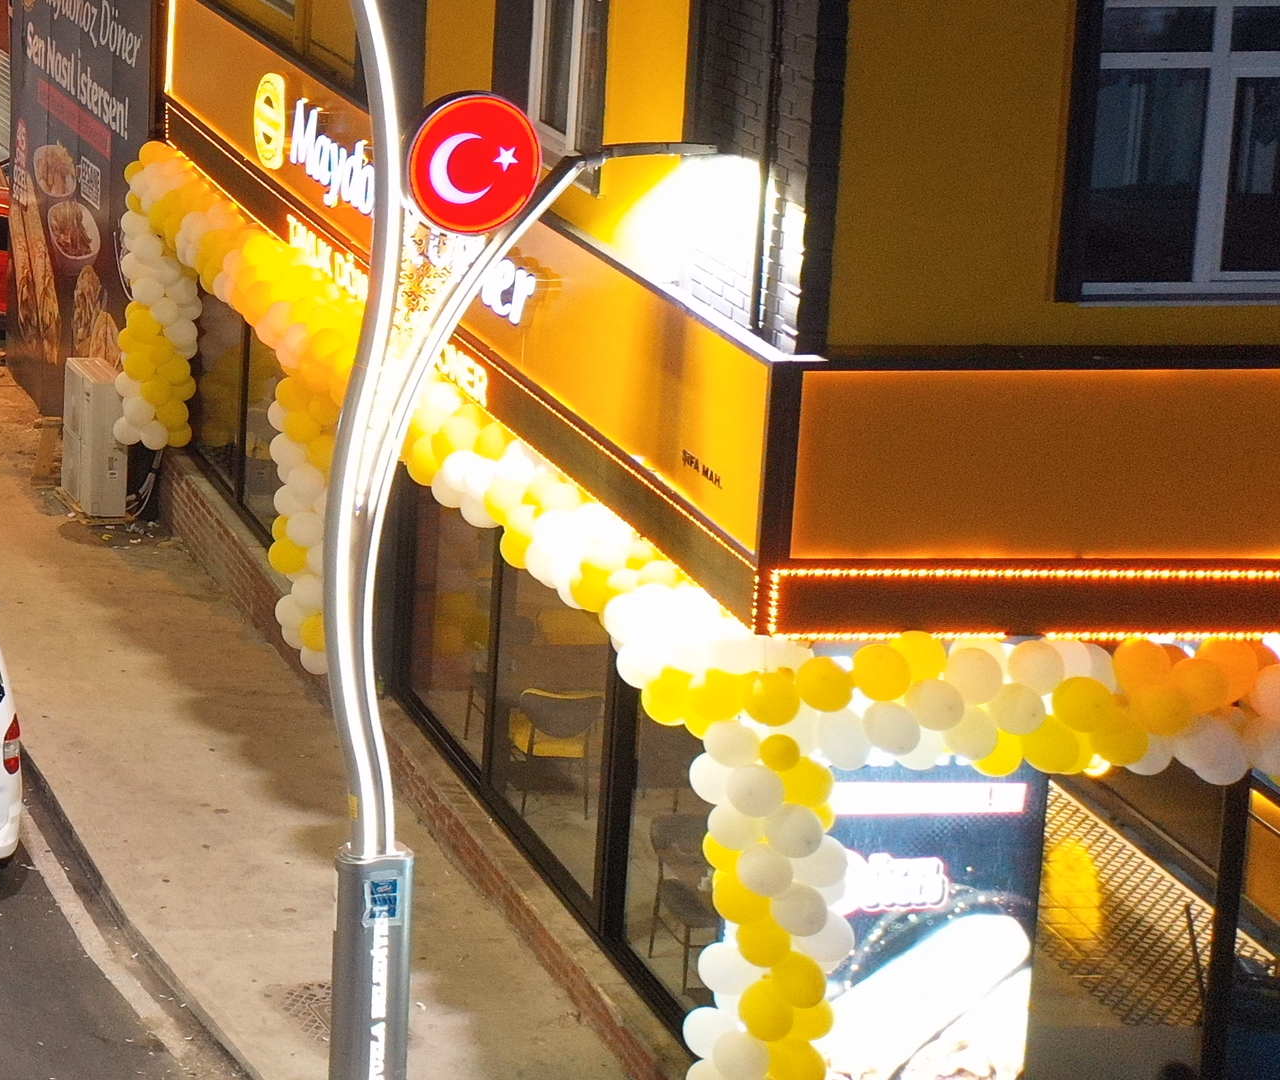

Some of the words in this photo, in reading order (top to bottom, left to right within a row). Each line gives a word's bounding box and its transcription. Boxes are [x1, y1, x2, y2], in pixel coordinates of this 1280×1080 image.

[26, 21, 46, 71] Sen
[99, 0, 143, 69] Döner
[290, 98, 375, 217] Maydo
[702, 464, 723, 490] MAH.
